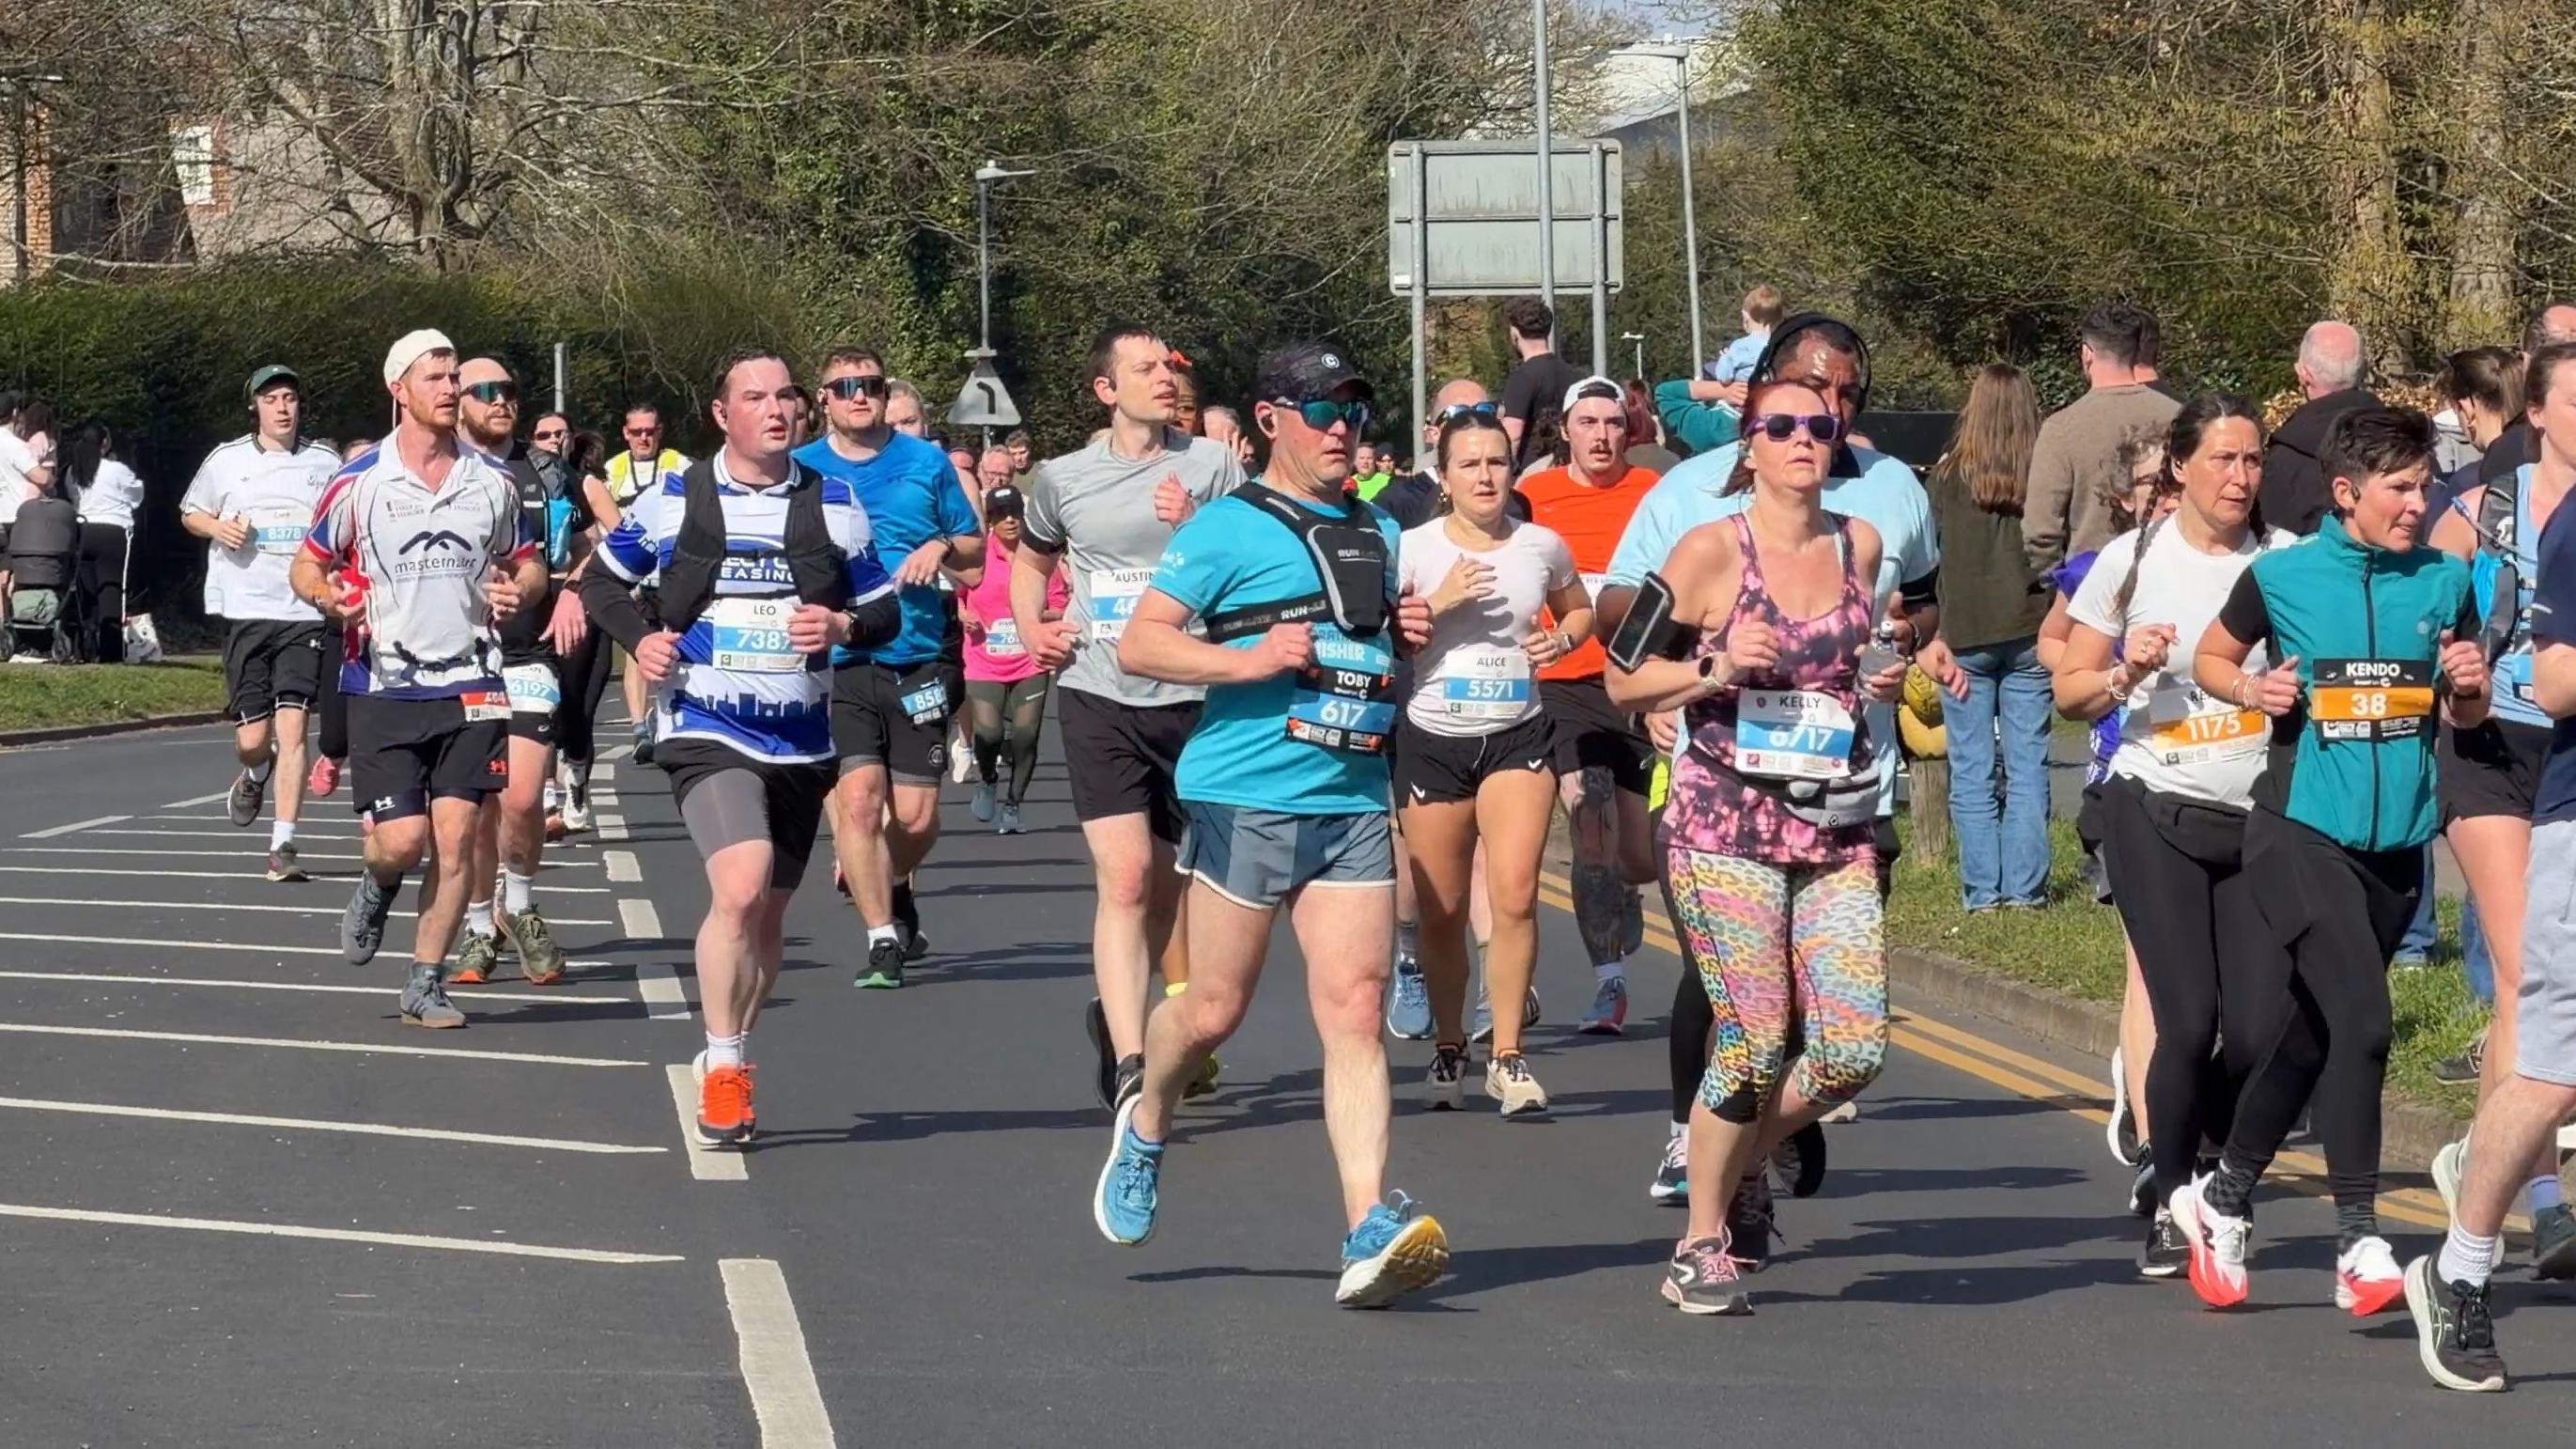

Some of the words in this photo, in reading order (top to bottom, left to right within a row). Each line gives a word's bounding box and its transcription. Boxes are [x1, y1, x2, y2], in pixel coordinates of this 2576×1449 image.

[721, 568, 795, 582] EASIN
[754, 605, 776, 615] LEO
[1477, 658, 1506, 667] ALICE
[2346, 662, 2400, 677] KENDO
[511, 678, 551, 697] 6197
[1336, 670, 1372, 688] TOBY
[1467, 679, 1513, 699] 5571
[1779, 696, 1821, 709] KELLY
[2351, 692, 2387, 716] 38
[1320, 700, 1367, 726] 617
[2187, 712, 2242, 741] 1175
[1769, 724, 1835, 752] 6717
